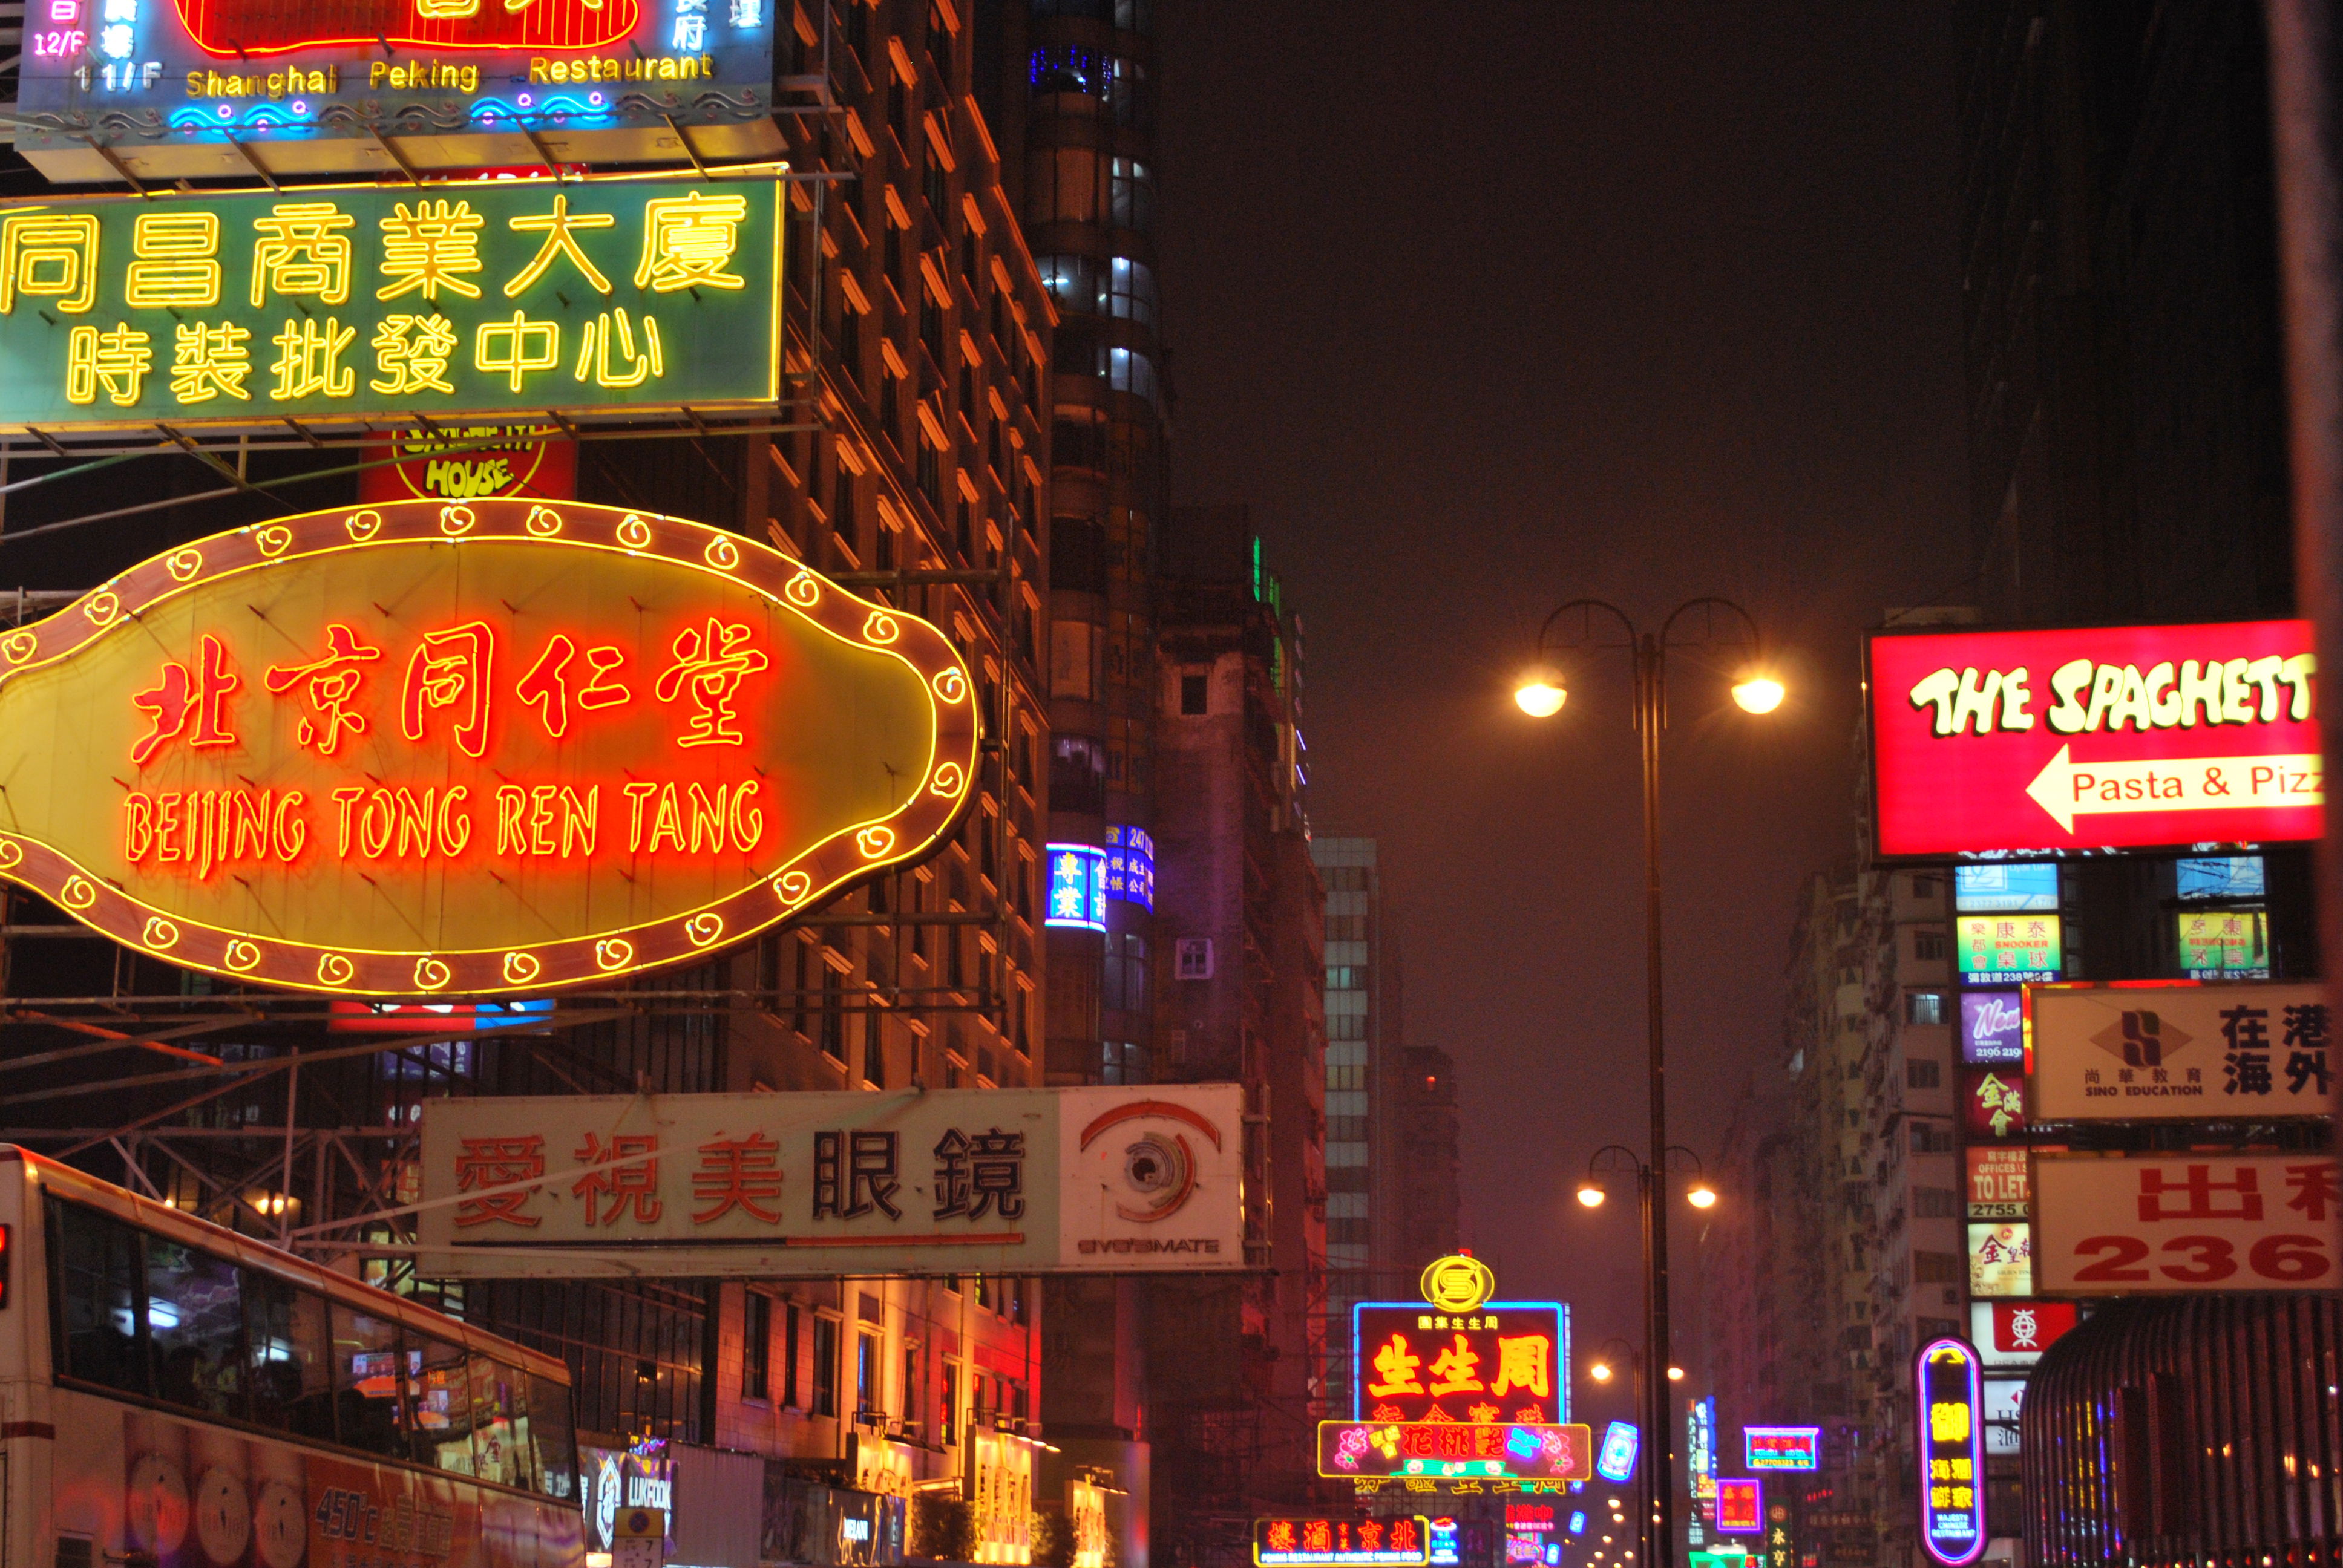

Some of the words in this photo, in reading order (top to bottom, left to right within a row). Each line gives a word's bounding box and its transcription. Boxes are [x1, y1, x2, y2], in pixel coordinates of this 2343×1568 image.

[34, 31, 88, 58] 12/F
[186, 64, 339, 99] Shanghai
[370, 60, 479, 93] Peking
[529, 53, 713, 84] Restaurant
[0, 191, 747, 315] 同昌商業大廈
[66, 306, 664, 407] 時裝批發中心
[425, 458, 514, 498] HOUSE
[131, 616, 768, 764] 北京同仁堂
[1909, 667, 2036, 736] THE
[2073, 771, 2183, 802] Pasta
[2203, 766, 2230, 797] &
[124, 788, 304, 881] BEIJING
[332, 786, 470, 858] TONG
[496, 784, 598, 858] REN
[624, 780, 763, 854] TANG
[1053, 851, 1083, 918] 專業
[1995, 940, 2049, 949] SNOOKER
[1997, 950, 2048, 969] 桌球
[1976, 1047, 2001, 1058] 2196
[2085, 1067, 2202, 1084] 尚華教育
[2086, 1086, 2118, 1097] SINO
[2125, 1085, 2203, 1096] EDUCATION
[2222, 1050, 2335, 1096] 海外
[454, 1126, 1027, 1228] 愛視美眼鏡
[1974, 1175, 1995, 1200] TO
[1998, 1175, 2027, 1199] LET
[1978, 1163, 2016, 1174] OFFICES
[1973, 1204, 2016, 1215] 2755
